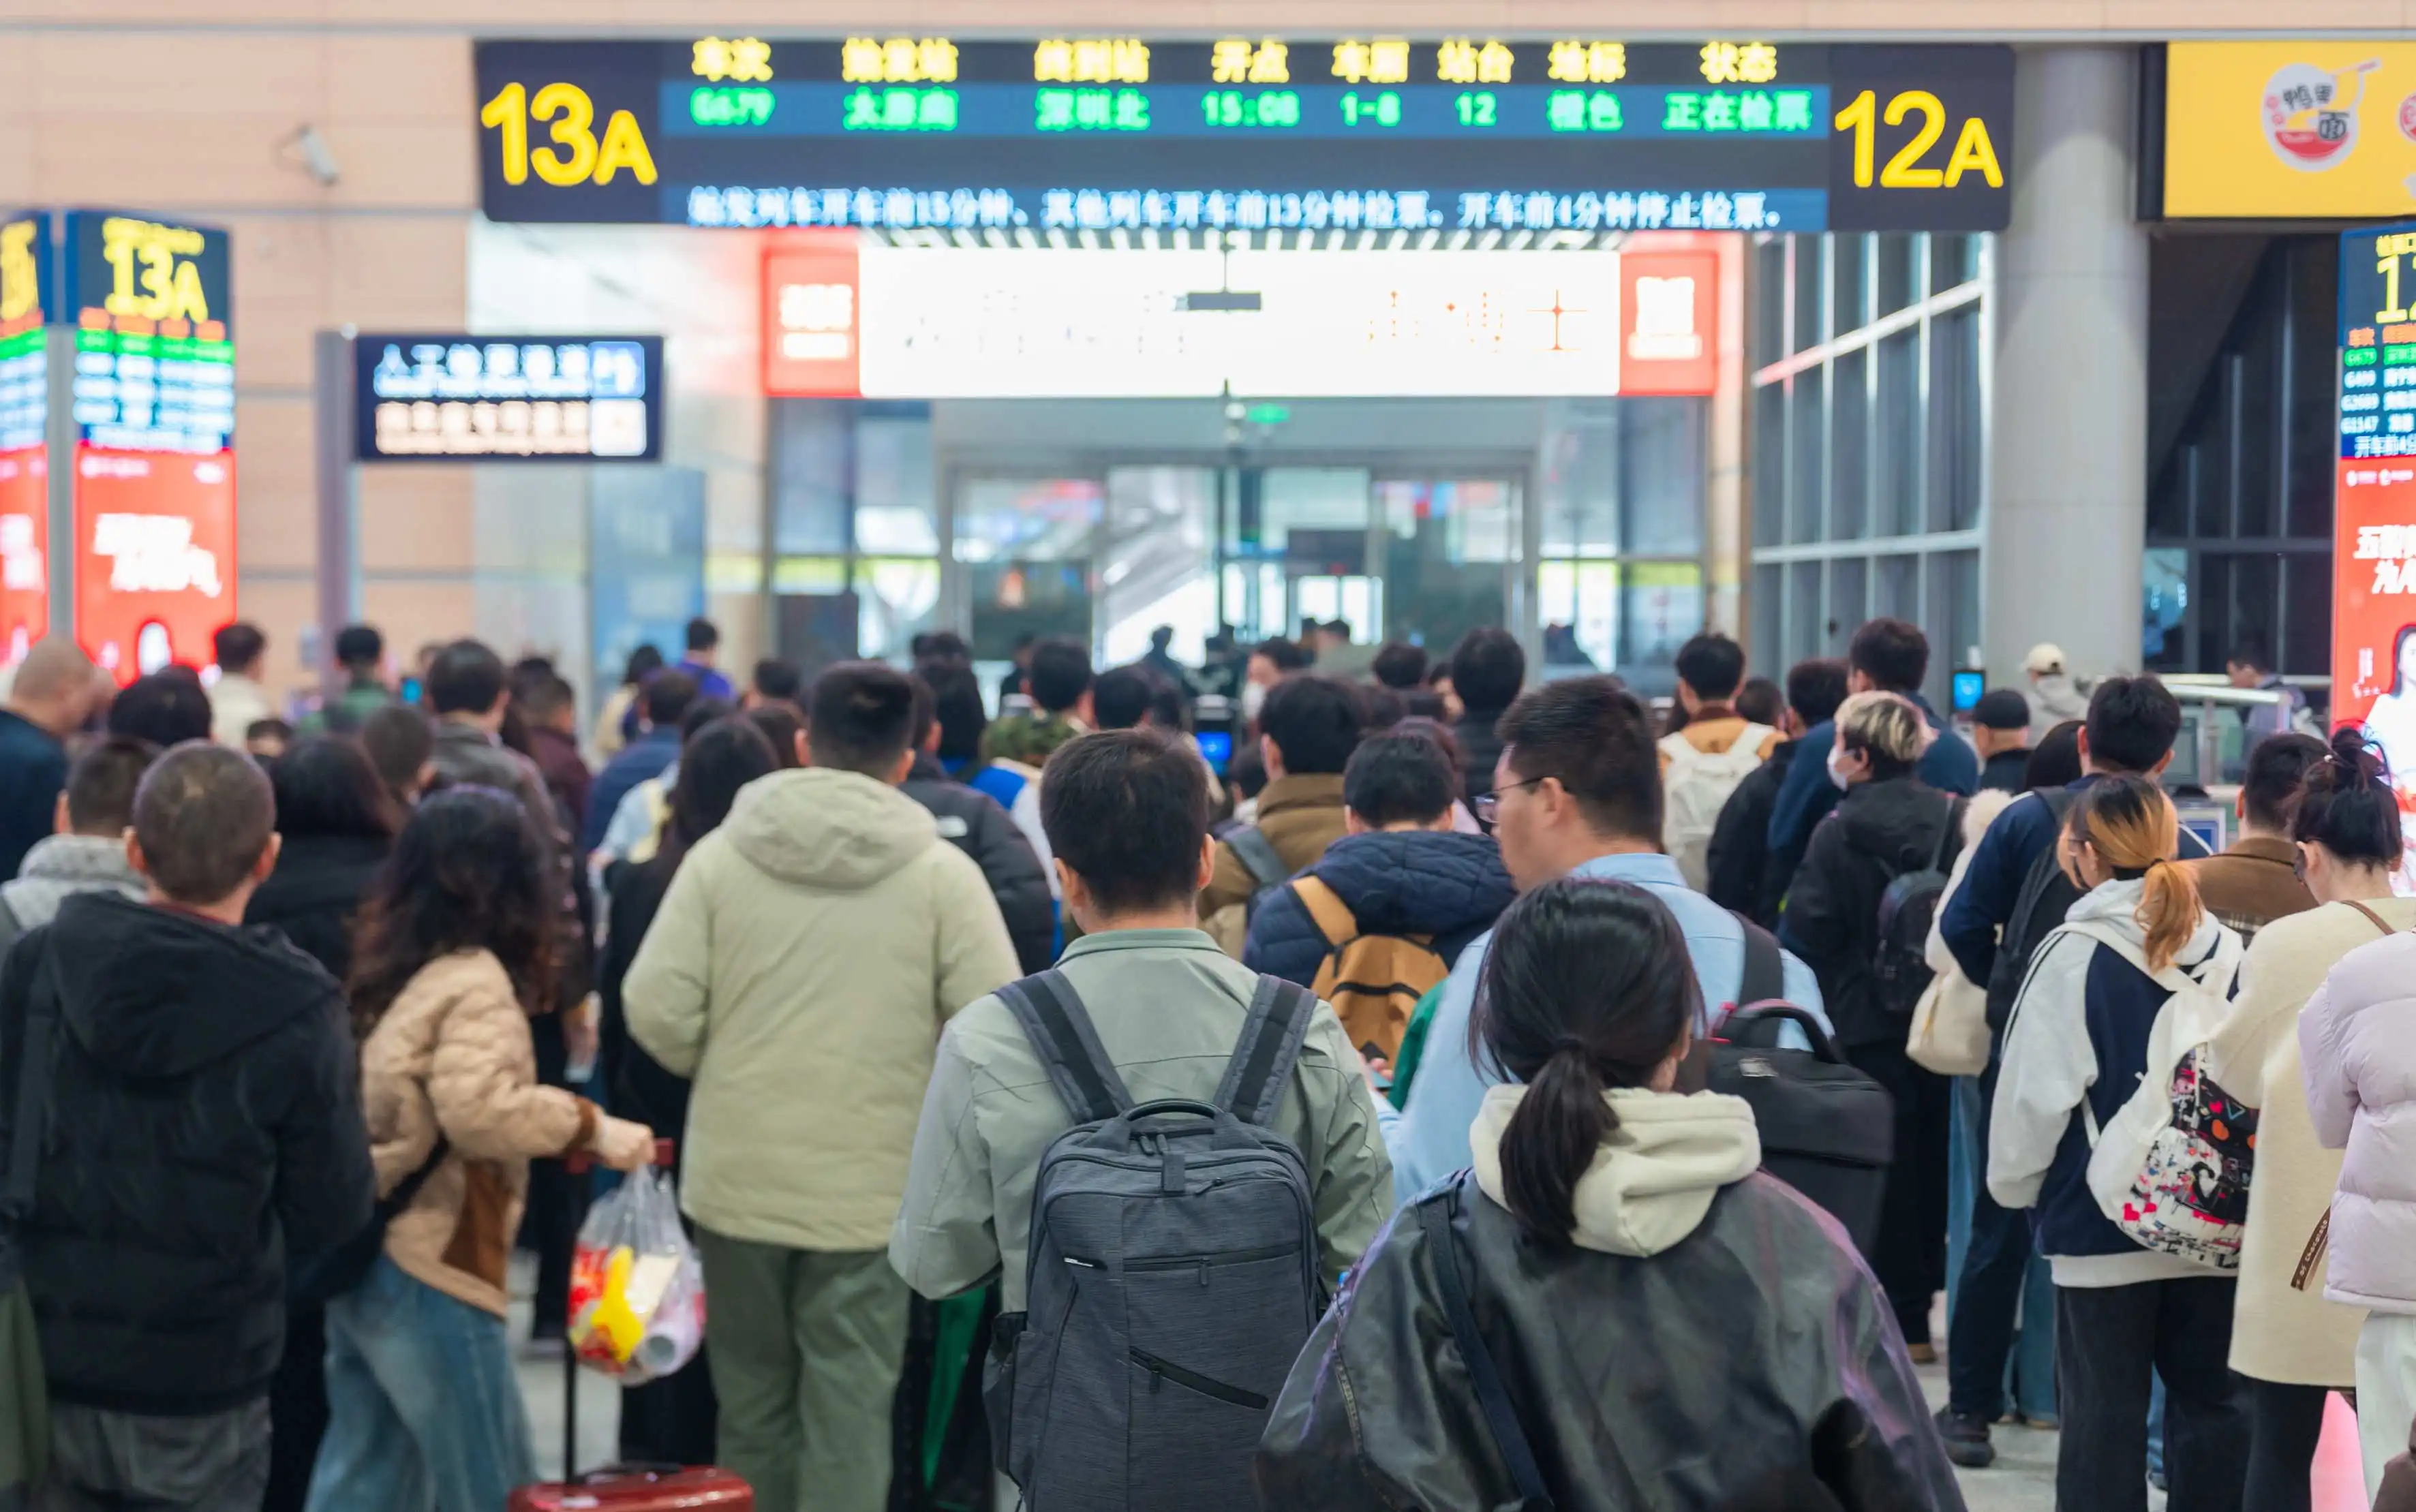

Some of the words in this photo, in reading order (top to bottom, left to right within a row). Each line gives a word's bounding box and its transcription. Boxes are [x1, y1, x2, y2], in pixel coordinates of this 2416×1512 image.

[1700, 42, 1777, 83] 状态
[481, 82, 658, 185] 13A
[1454, 91, 1497, 127] 12
[1662, 91, 1813, 132] 正在检票
[1835, 90, 2004, 188] 12A
